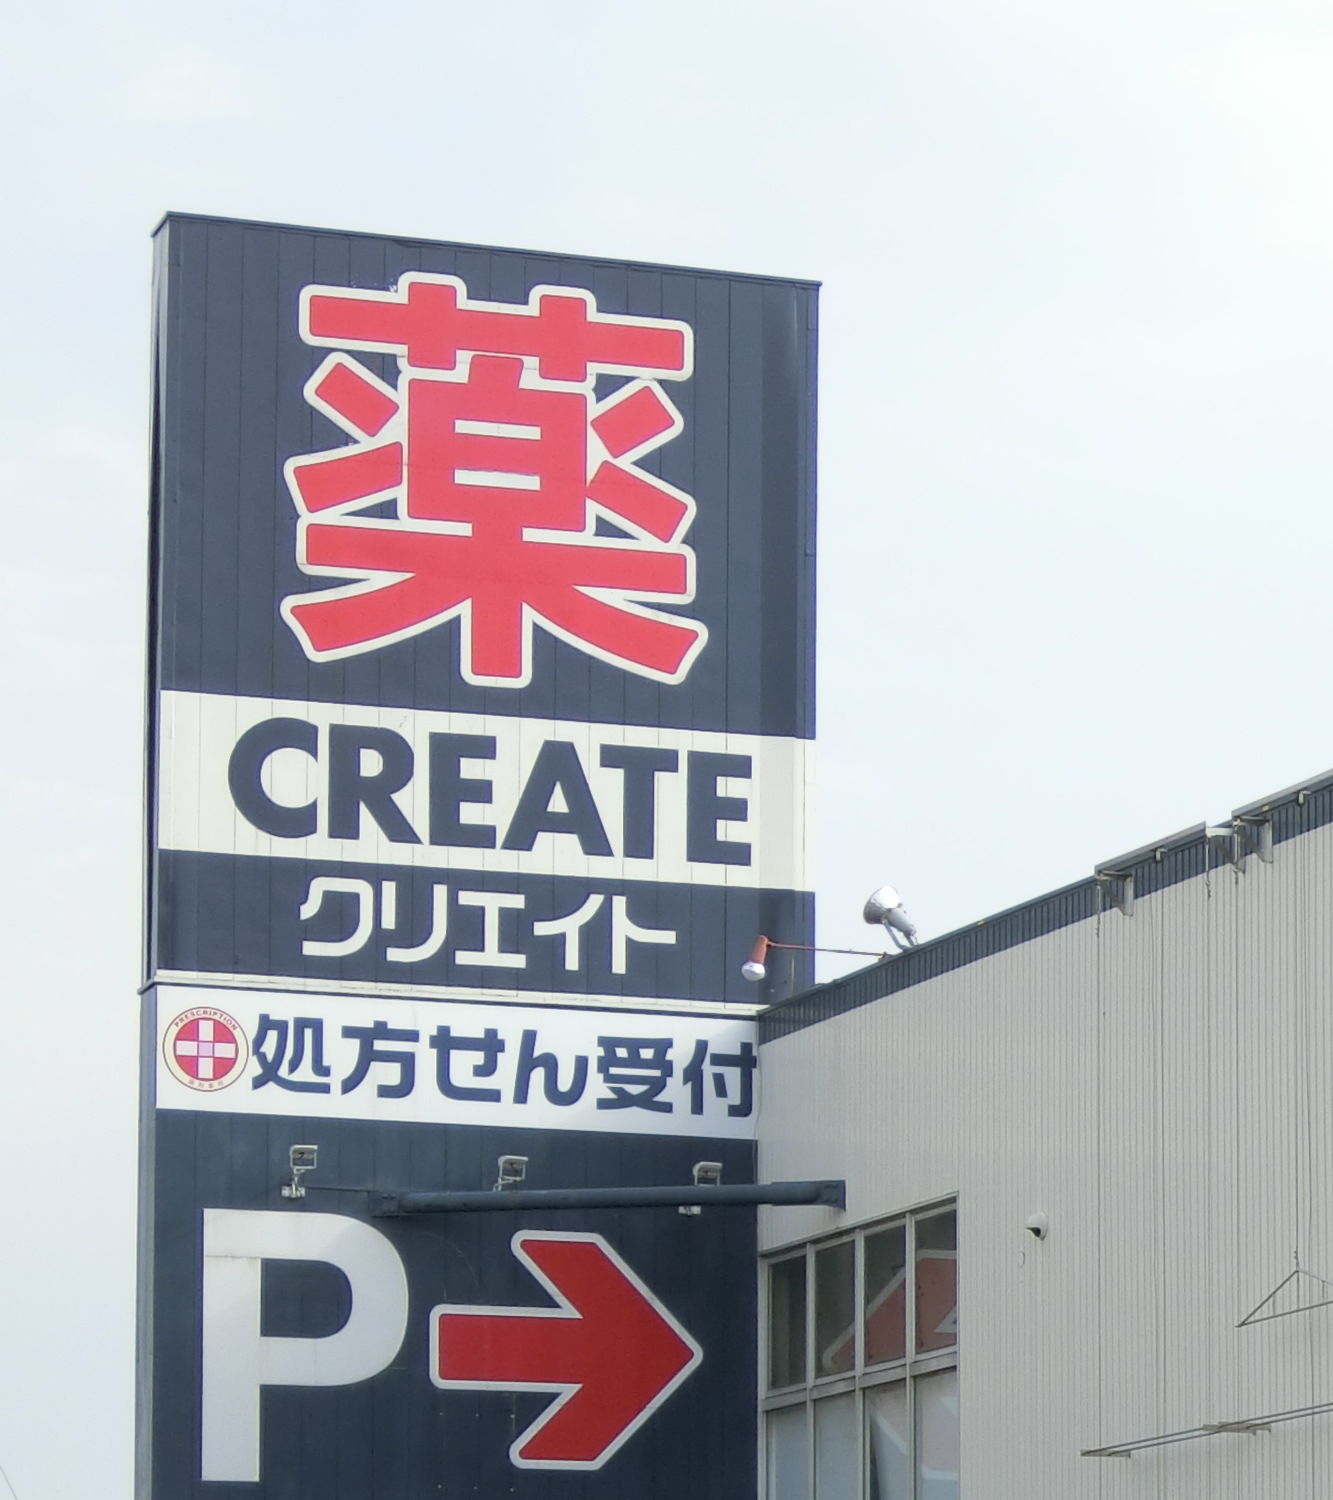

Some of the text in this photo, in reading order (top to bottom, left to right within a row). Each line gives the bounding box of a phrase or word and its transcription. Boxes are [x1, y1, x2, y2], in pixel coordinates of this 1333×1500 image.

[281, 271, 708, 688] 薬
[227, 717, 752, 867] CREATE
[300, 877, 676, 974] クリエイト
[174, 1009, 239, 1031] PRESCRIPTION
[251, 1012, 758, 1118] 処方せん受付
[200, 1208, 409, 1482] P
